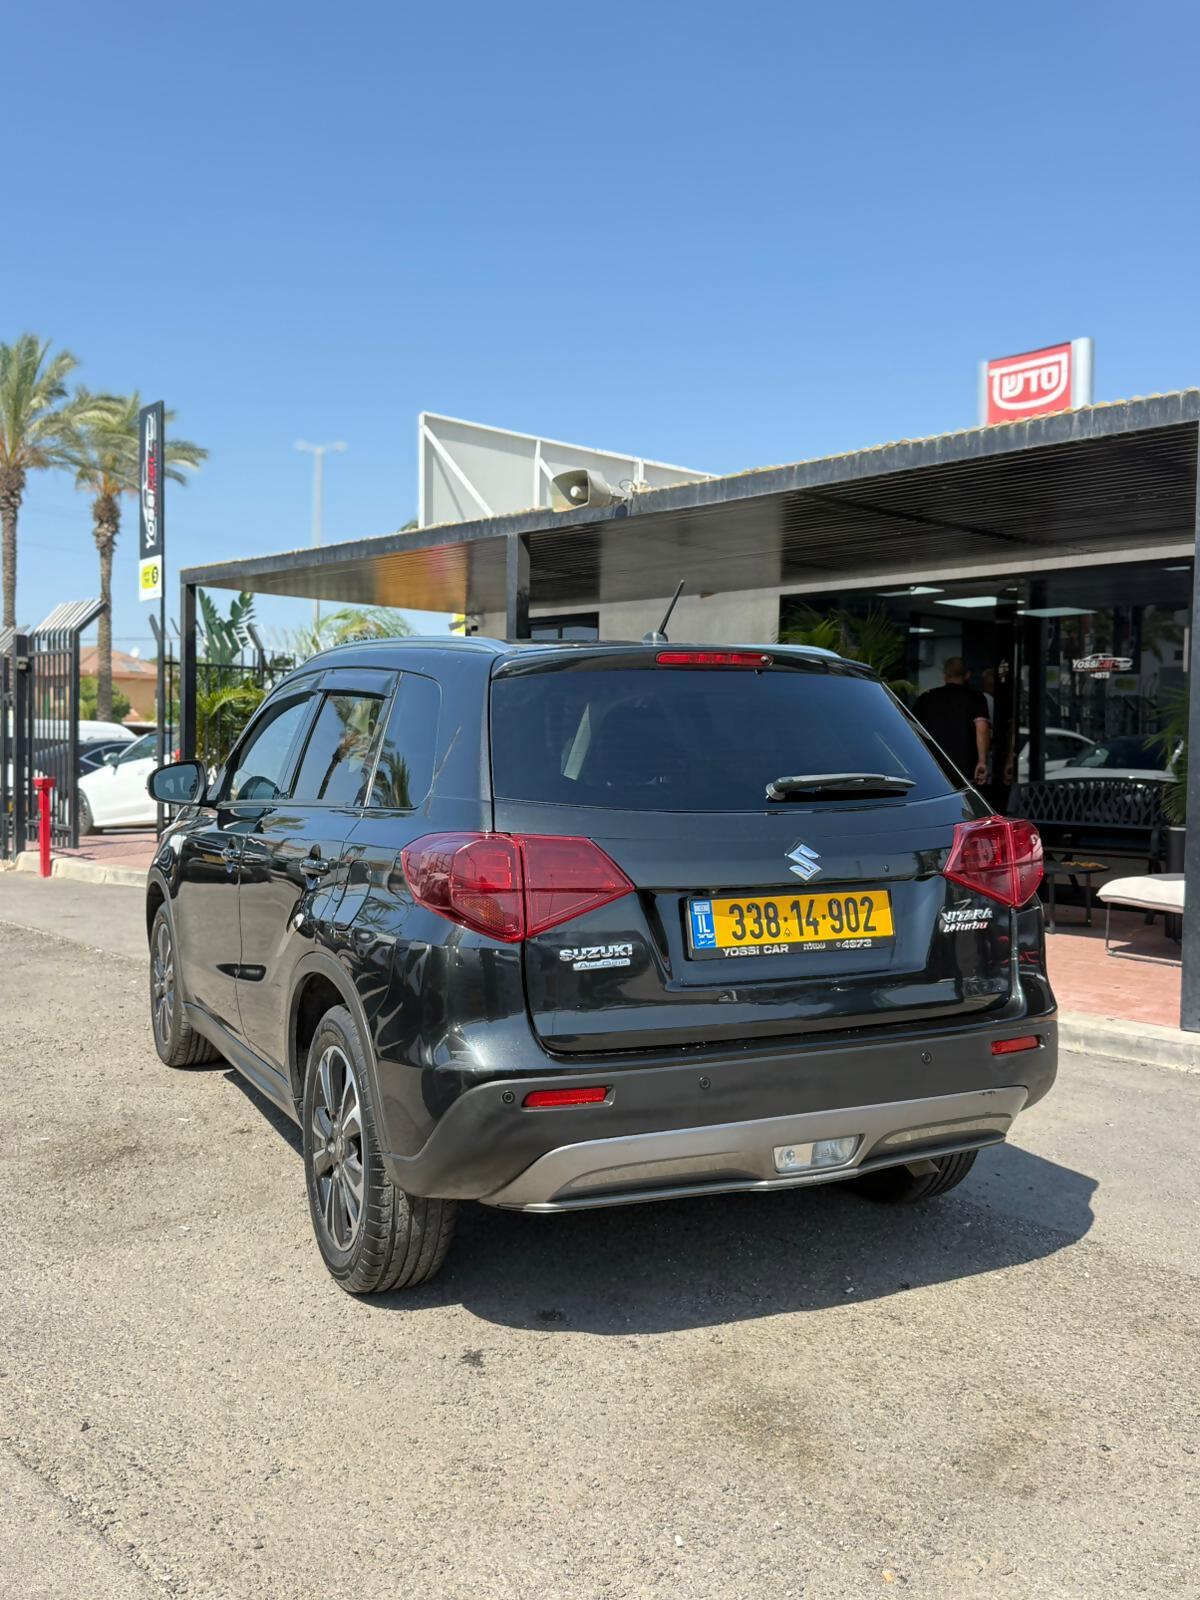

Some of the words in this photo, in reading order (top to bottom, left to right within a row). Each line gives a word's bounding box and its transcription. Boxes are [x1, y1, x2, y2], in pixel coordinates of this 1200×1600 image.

[697, 914, 711, 933] IL
[559, 943, 633, 962] SUZUKI
[763, 944, 790, 955] CAR
